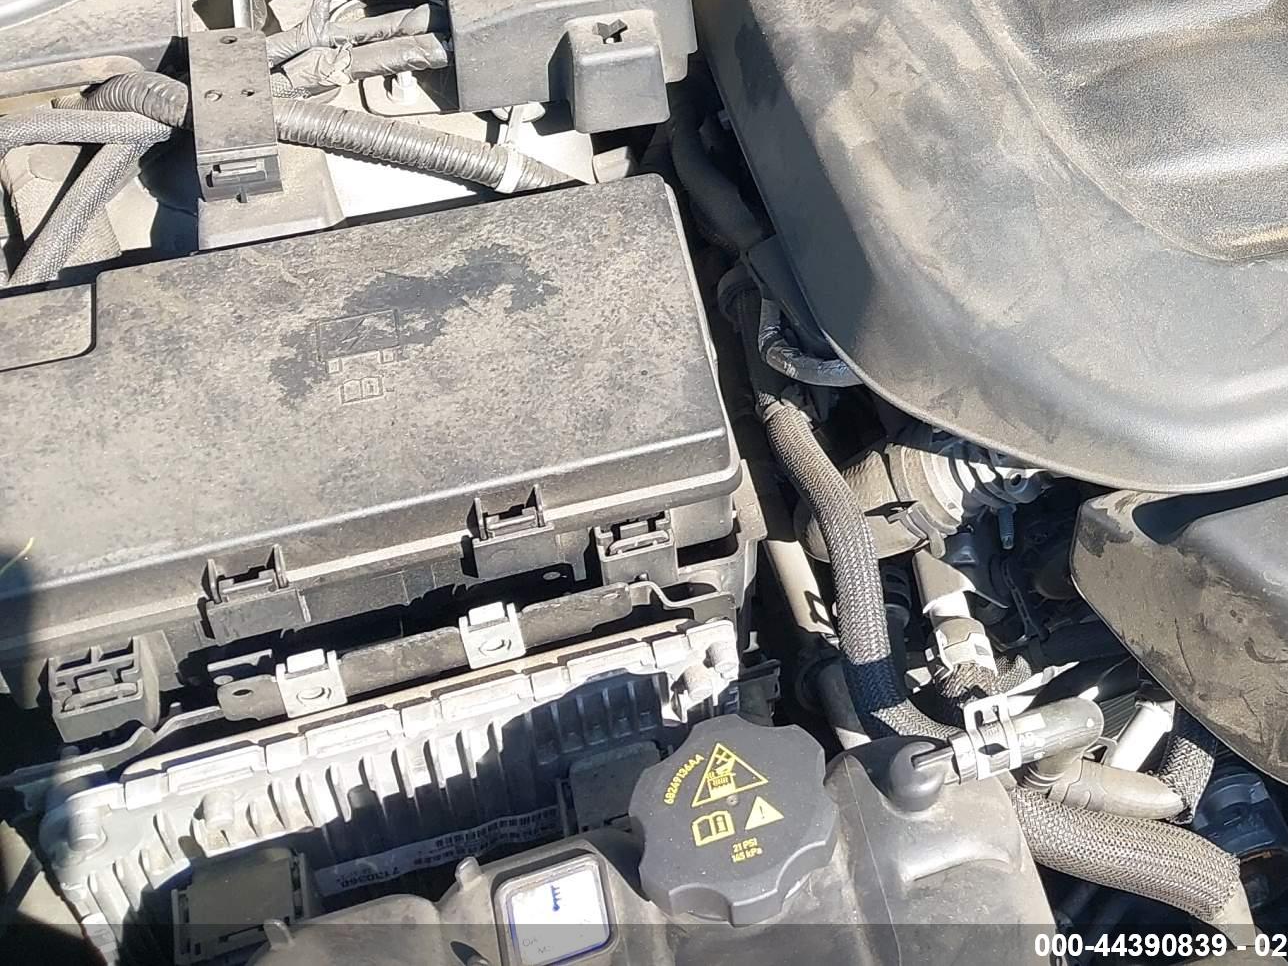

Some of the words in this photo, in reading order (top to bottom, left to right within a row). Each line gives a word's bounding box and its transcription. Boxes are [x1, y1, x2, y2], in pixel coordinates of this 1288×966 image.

[732, 842, 743, 853] 21
[742, 837, 758, 850] PSI
[745, 846, 763, 859] kPa
